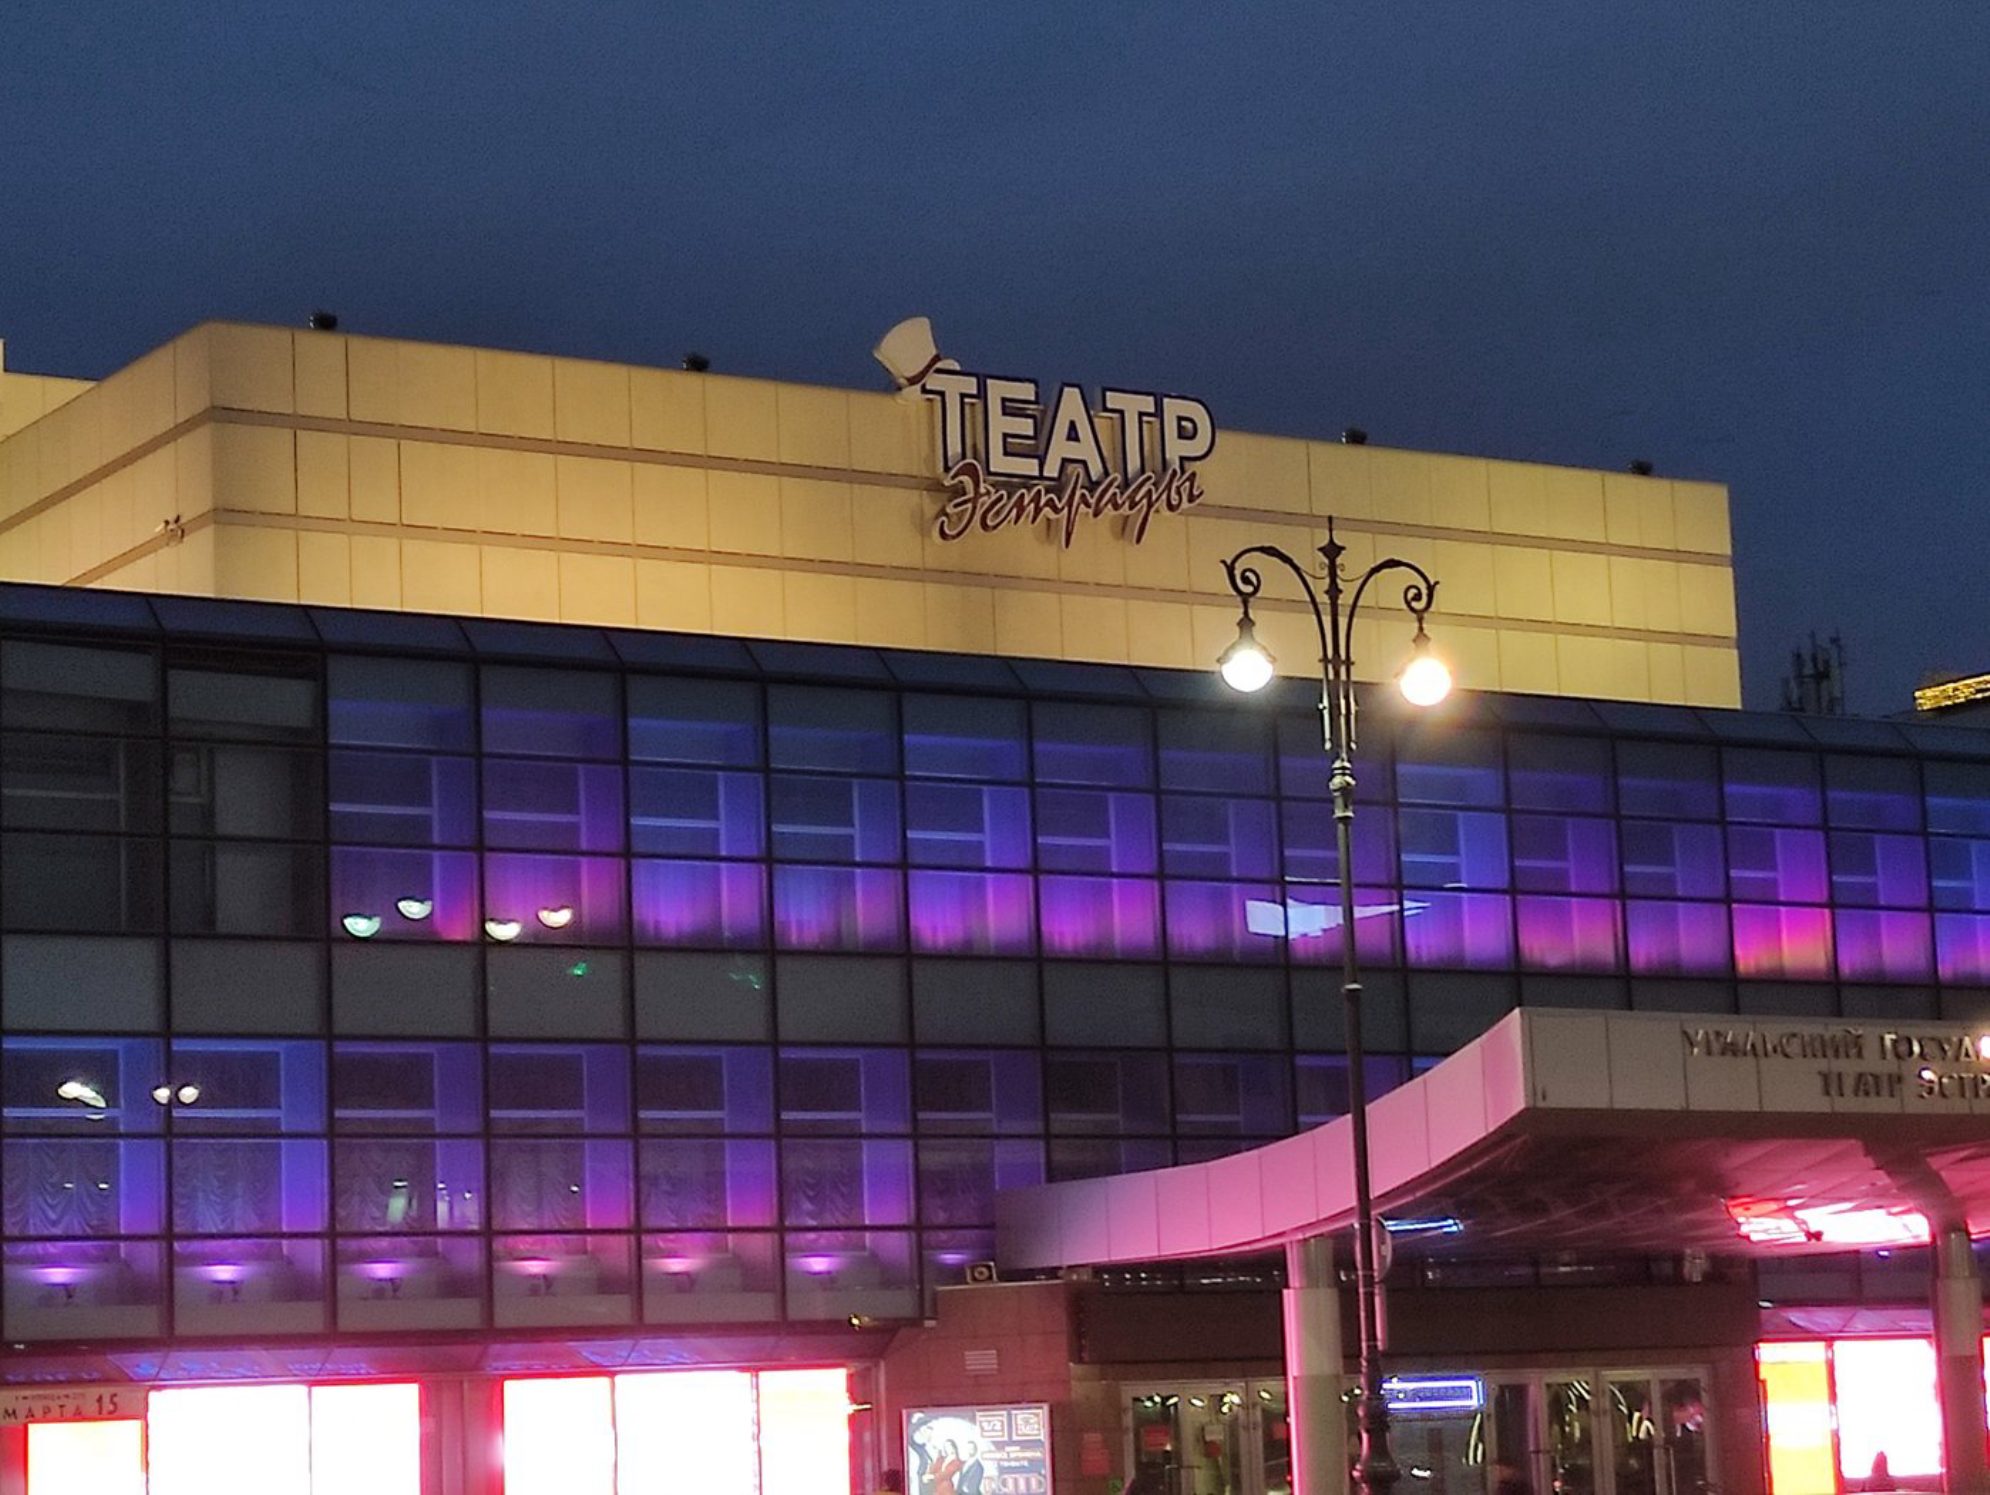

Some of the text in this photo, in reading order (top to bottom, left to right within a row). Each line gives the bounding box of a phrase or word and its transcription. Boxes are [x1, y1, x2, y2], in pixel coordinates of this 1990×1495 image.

[921, 369, 1216, 483] ТЕАТР
[936, 459, 1205, 549] Эстрады
[1682, 1027, 1989, 1061] УРАЛЬСКИЙ ГОСУД
[1818, 1070, 1901, 1098] ТЕАТР
[3, 1404, 83, 1420] МАРТА
[95, 1393, 118, 1415] 15
